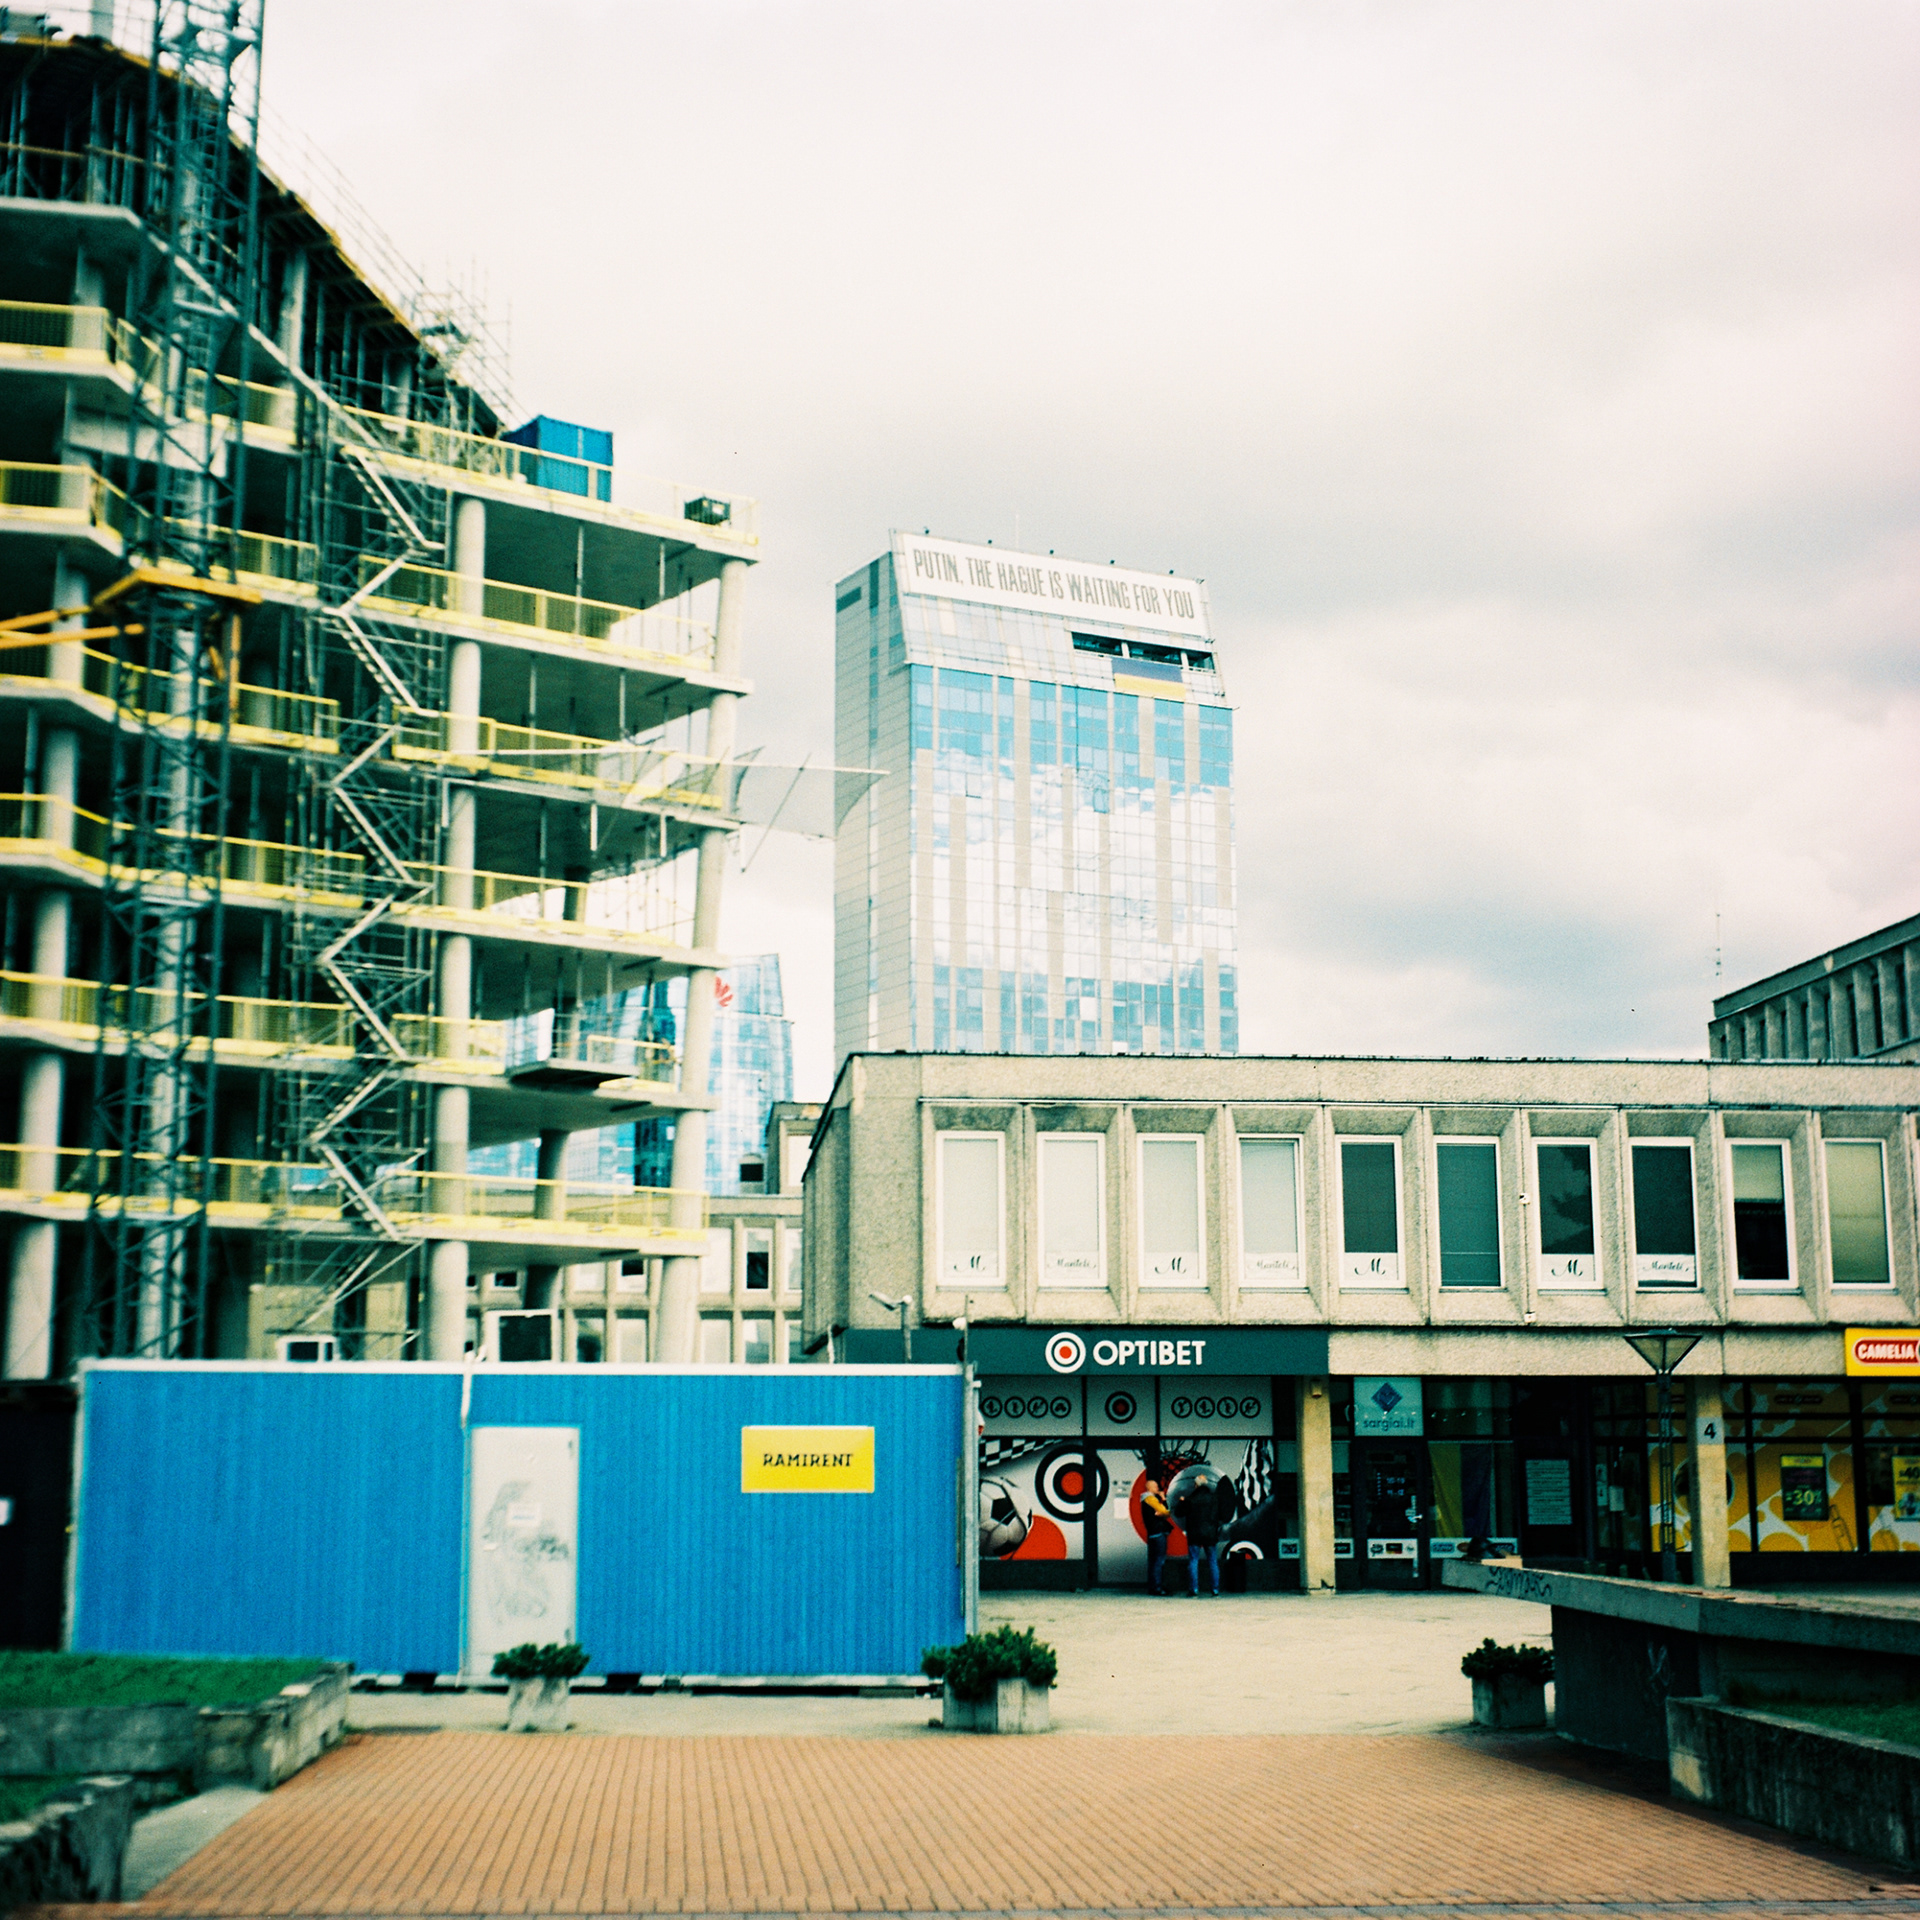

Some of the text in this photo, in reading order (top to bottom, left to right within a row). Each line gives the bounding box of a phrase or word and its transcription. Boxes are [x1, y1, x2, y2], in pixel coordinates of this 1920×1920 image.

[913, 549, 1195, 619] PUTIN, THE HAGUE IS WAITING FOR YOU
[1154, 1256, 1187, 1275] M
[1354, 1257, 1386, 1275] M
[1551, 1258, 1583, 1277] M
[1093, 1340, 1206, 1366] OPTIBET
[1858, 1343, 1915, 1360] CAMELIA
[1704, 1422, 1717, 1439] 4
[762, 1453, 854, 1467] RAMIRENT
